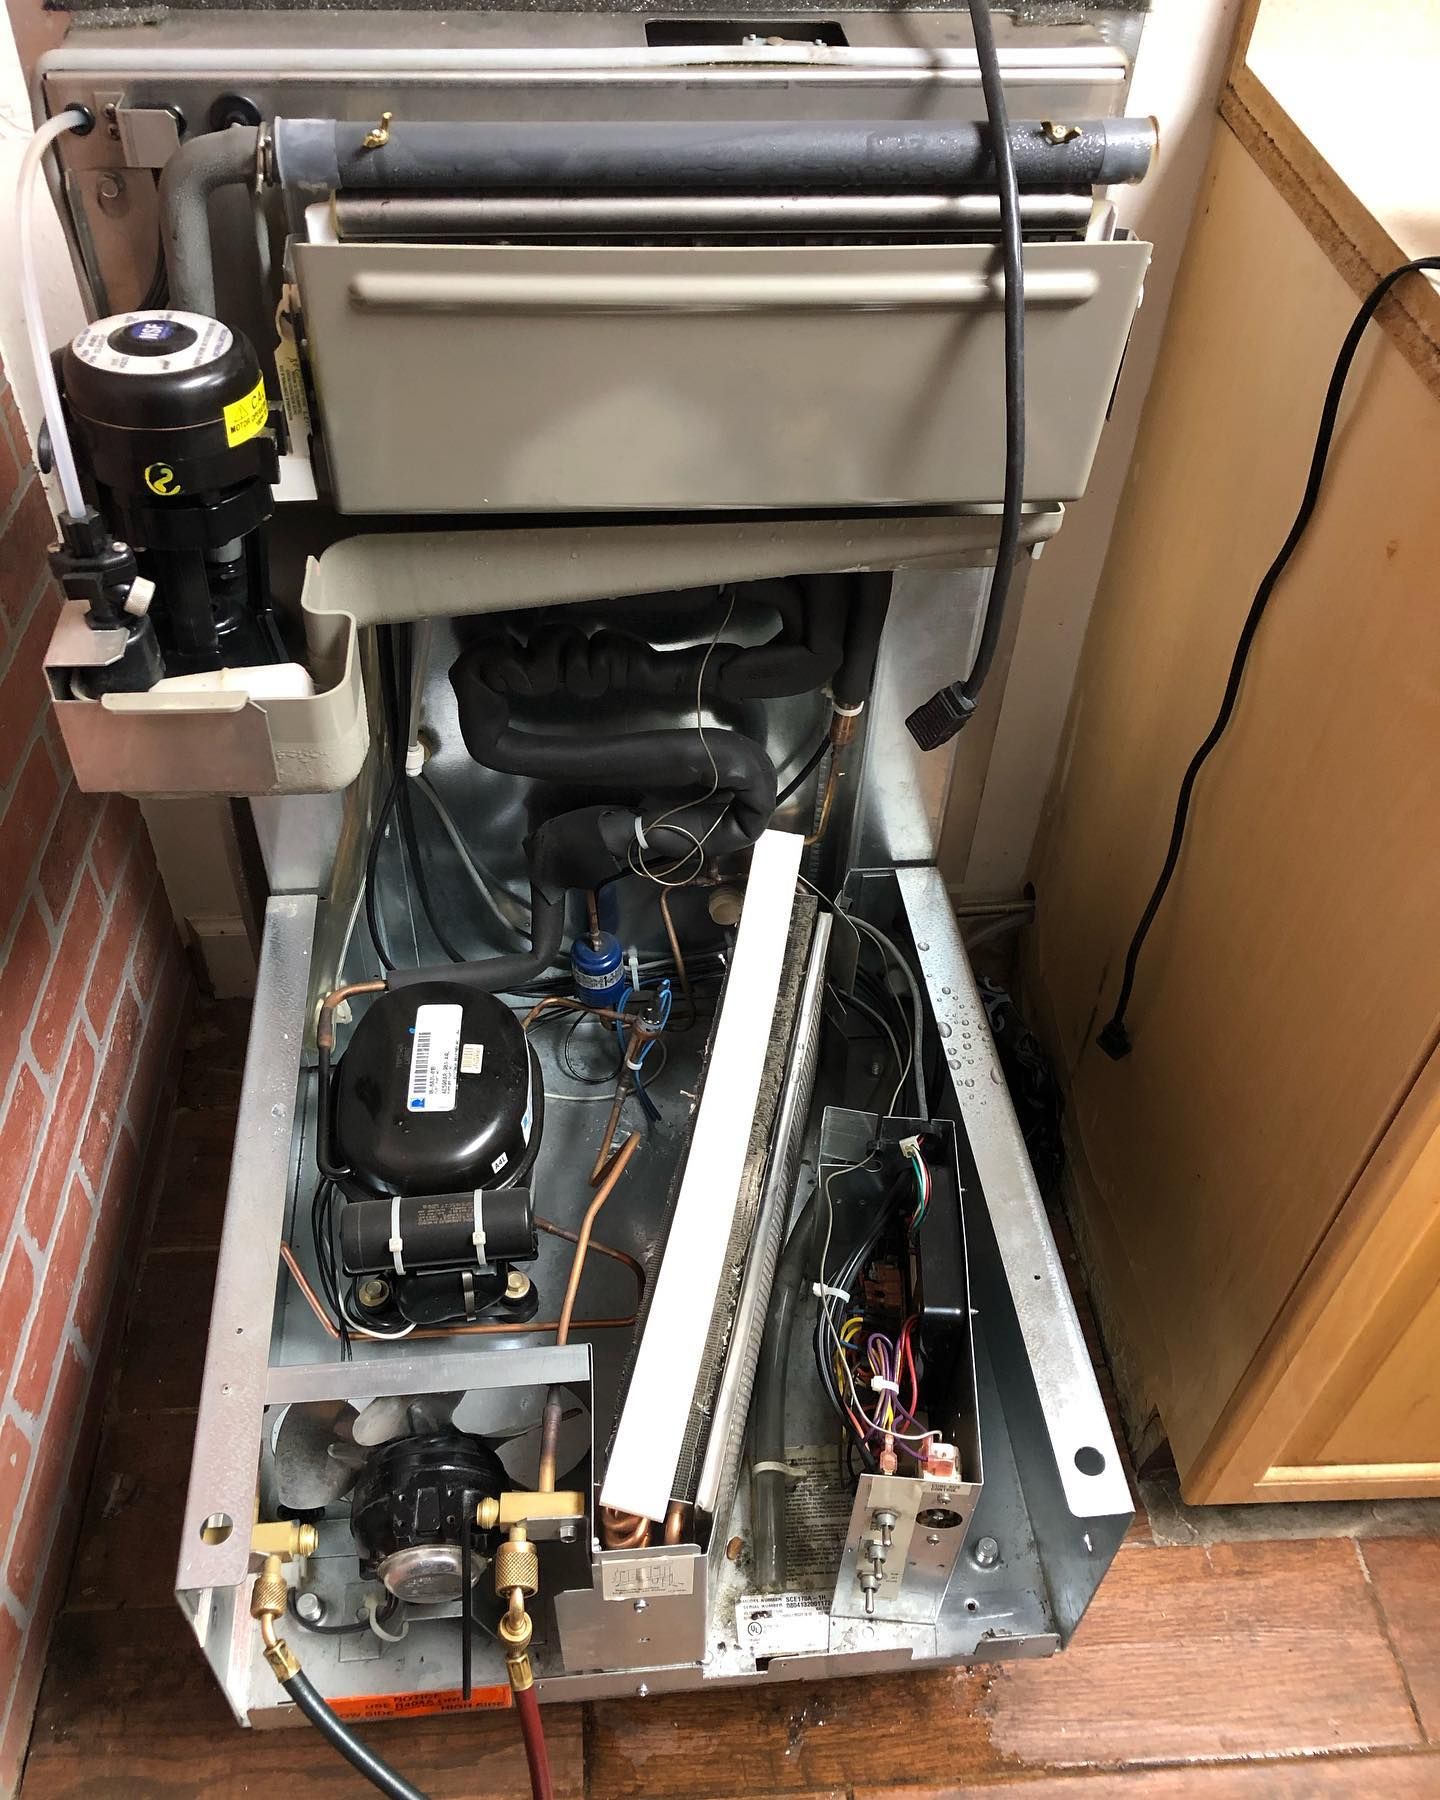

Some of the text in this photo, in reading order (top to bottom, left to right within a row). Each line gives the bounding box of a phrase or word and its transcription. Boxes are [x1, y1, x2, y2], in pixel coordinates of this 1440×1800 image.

[139, 323, 163, 339] NSF
[154, 468, 173, 493] 2
[494, 1156, 506, 1170] A4L
